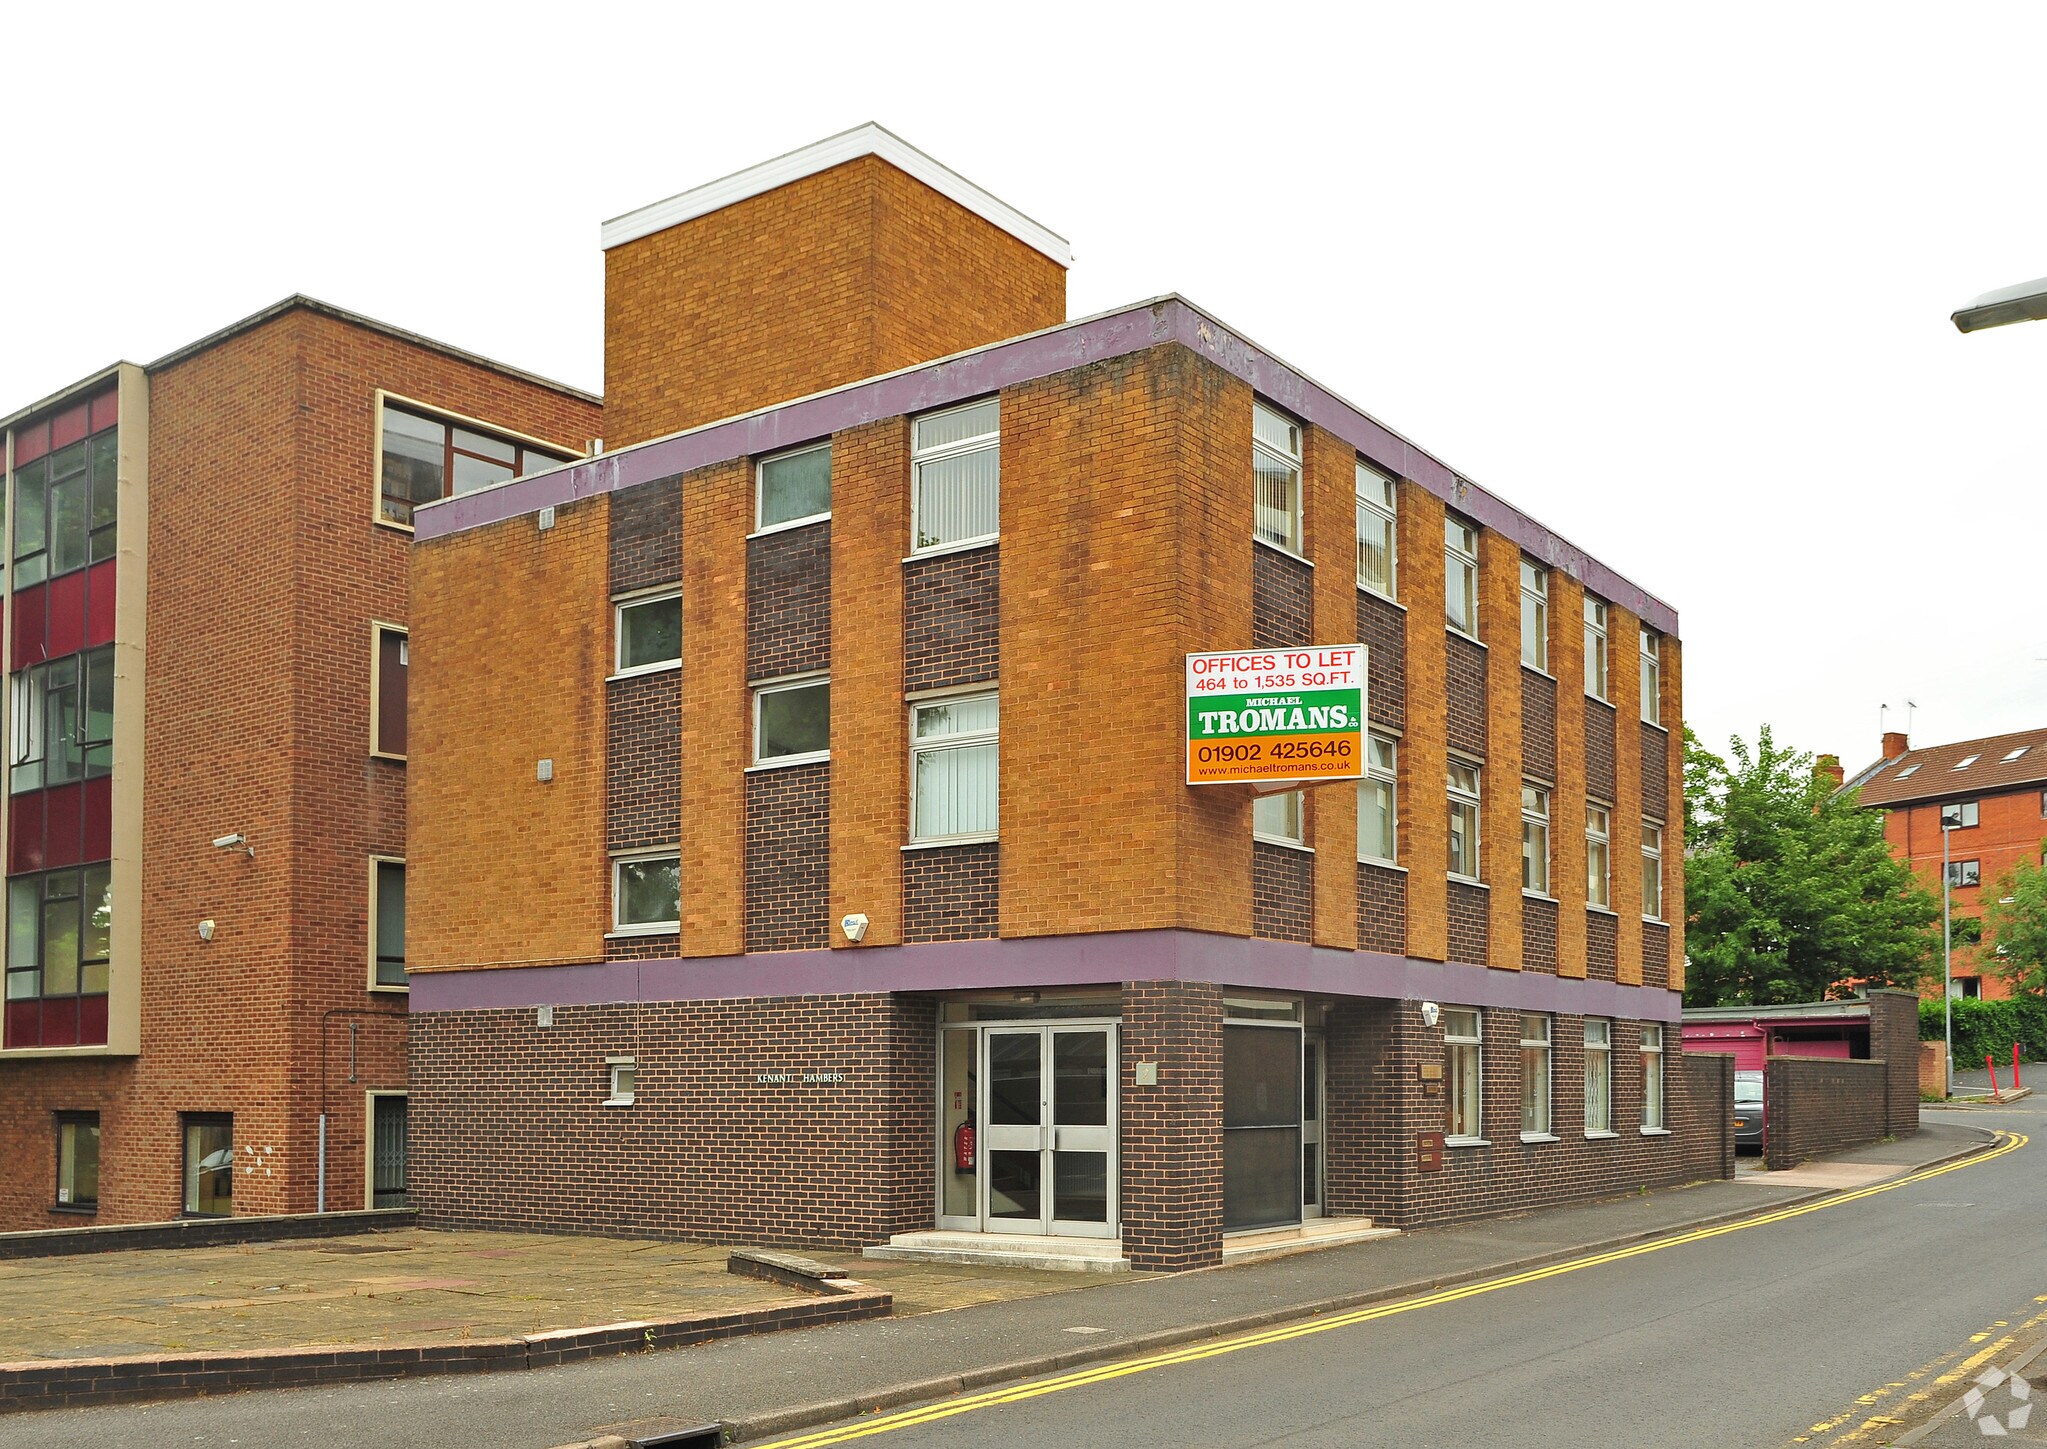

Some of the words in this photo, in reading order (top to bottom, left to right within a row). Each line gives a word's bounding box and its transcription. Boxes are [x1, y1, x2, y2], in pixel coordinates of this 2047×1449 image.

[1192, 654, 1276, 675] OFFICES
[1283, 652, 1311, 669] TO
[1318, 650, 1356, 667] LET
[1196, 677, 1226, 691] 464
[1233, 676, 1248, 689] to
[1255, 674, 1295, 690] 1,535
[1301, 671, 1354, 686] SQ.FT.
[1246, 696, 1303, 707] MICHAEL
[1198, 704, 1348, 734] TROMANS
[1198, 744, 1262, 763] 01902
[1270, 740, 1351, 760] 425646
[1198, 760, 1351, 776] www.michaeltromans.co.uk
[757, 1074, 792, 1083] KENANT
[803, 1073, 844, 1083] HAMBERS
